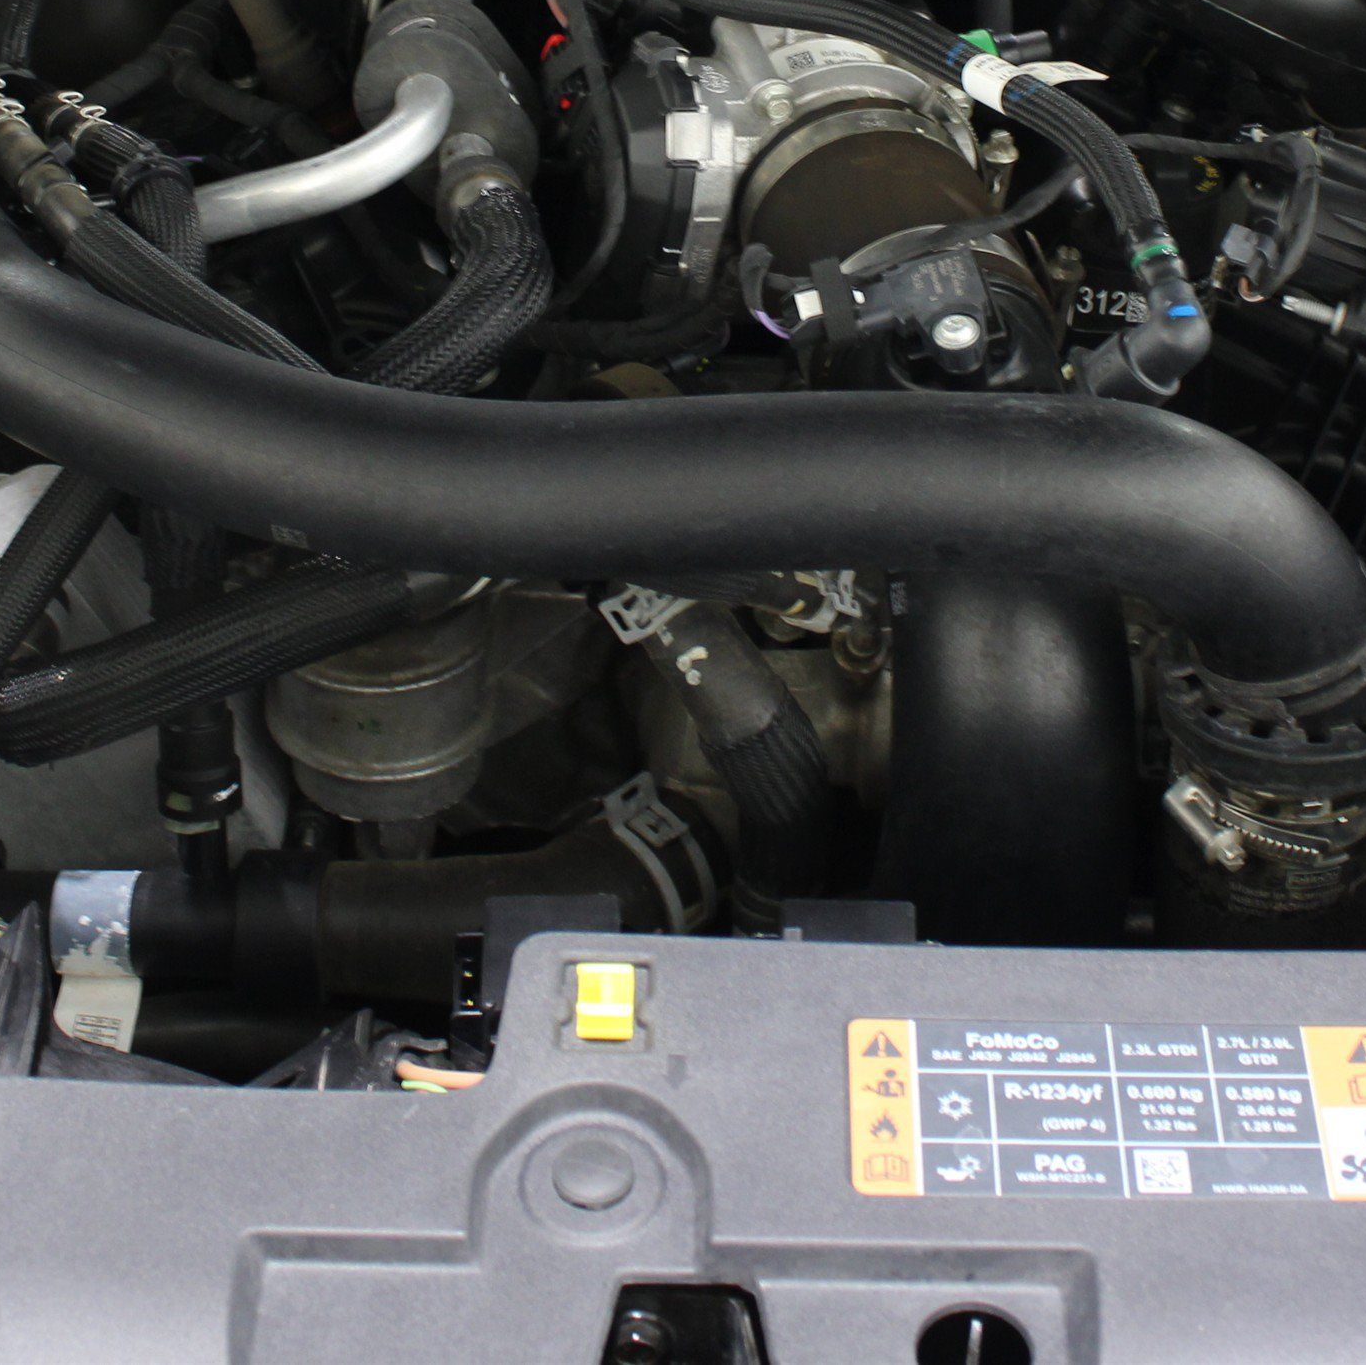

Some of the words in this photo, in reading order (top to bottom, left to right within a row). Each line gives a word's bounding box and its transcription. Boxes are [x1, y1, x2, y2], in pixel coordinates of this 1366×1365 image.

[1076, 285, 1129, 317] 312
[965, 1032, 1060, 1050] FoMoCo
[1216, 1036, 1251, 1050] 2.7L
[931, 1049, 963, 1061] SAE
[1121, 1043, 1156, 1057] 2.3L
[1004, 1081, 1104, 1104] R-1234yf
[1126, 1084, 1177, 1101] 0.600
[1179, 1085, 1205, 1103] kg
[1277, 1086, 1303, 1105] kg
[1176, 1105, 1197, 1117] oz
[1277, 1106, 1297, 1118] oz
[1042, 1117, 1088, 1133] (GWP
[1089, 1118, 1107, 1134] 4)
[1173, 1119, 1198, 1132] lbs
[1273, 1120, 1298, 1133] lbs
[1034, 1153, 1087, 1172] PAG
